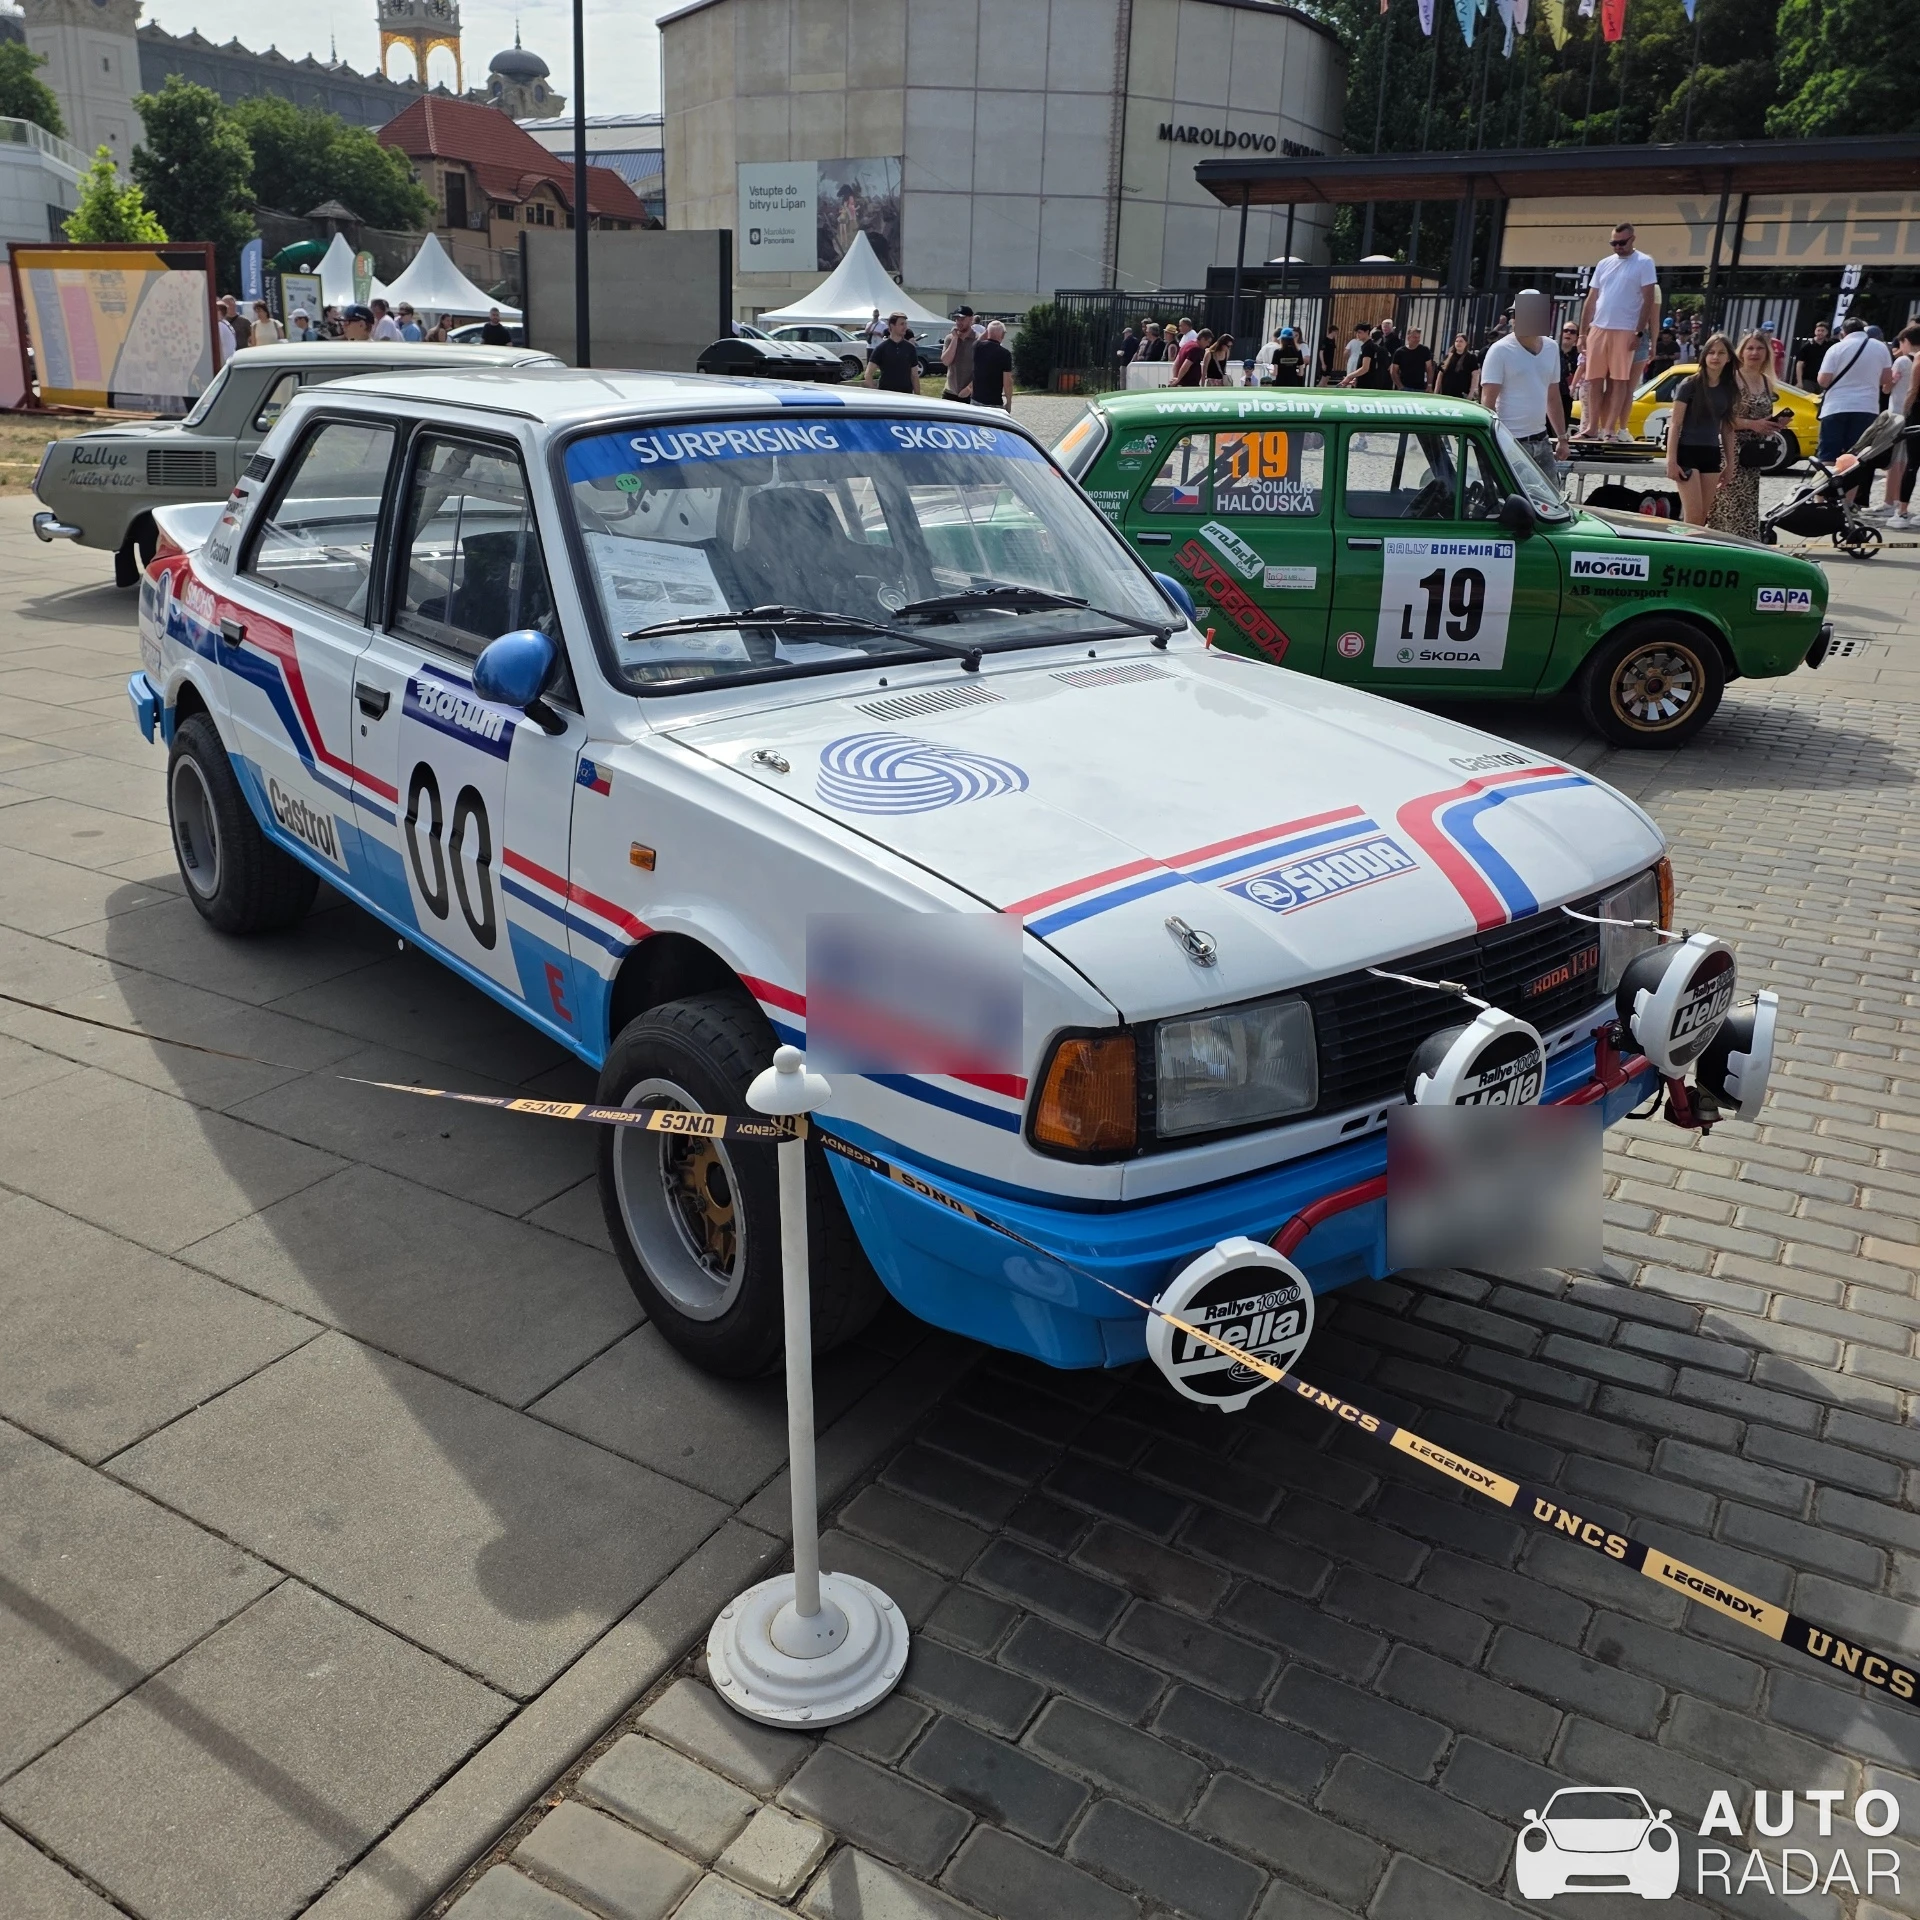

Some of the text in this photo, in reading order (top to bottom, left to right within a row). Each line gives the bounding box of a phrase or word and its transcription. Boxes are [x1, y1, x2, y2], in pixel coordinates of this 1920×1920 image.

[1159, 123, 1277, 152] MAROLDOVO
[749, 185, 798, 200] Vstupte do
[749, 200, 771, 211] bitvy
[780, 199, 806, 211] Lipan
[763, 228, 796, 236] Maroldovo
[1155, 401, 1230, 413] www.
[1238, 399, 1322, 418] plosiny
[1345, 401, 1463, 417] bahnik.cz
[71, 446, 129, 470] Rallye
[630, 425, 839, 463] SURPRISING
[618, 477, 638, 487] 118
[1251, 478, 1314, 497] Soukup
[1216, 495, 1315, 512] HALOUSKA
[209, 538, 232, 566] Castrol
[1386, 542, 1429, 555] RALLY
[1430, 543, 1493, 557] BOHEMIA
[1573, 560, 1646, 578] MOGUL
[1660, 564, 1740, 590] ŠKODA
[186, 582, 216, 619] SACHS
[1174, 539, 1291, 664] SVOBODA
[1419, 567, 1486, 642] 19
[1569, 585, 1669, 599] AB motorsport
[1419, 649, 1481, 662] ŠKODA
[417, 680, 506, 742] Barum
[1448, 752, 1530, 772] Castrol
[269, 778, 339, 861] Castrol
[404, 761, 496, 950] 00
[1281, 842, 1414, 899] ŠKODA
[1572, 946, 1598, 976] 130
[1674, 987, 1731, 1037] Hella
[1479, 1048, 1540, 1088] Rallye 1000
[517, 1101, 573, 1116] UNCS
[587, 1109, 642, 1123] LEGENDY
[660, 1113, 715, 1135] UNCS
[736, 1123, 784, 1137] EGENDY
[820, 1134, 878, 1168] LEGENDY
[901, 1172, 965, 1214] UNCS
[1204, 1285, 1301, 1321] Rallye 1000
[1181, 1309, 1300, 1360] Hella
[1296, 1381, 1381, 1433] UNCS
[1409, 1439, 1496, 1490] LEGENDY
[1533, 1497, 1628, 1560] UNCS
[1661, 1563, 1764, 1623] LEGENDY
[1806, 1626, 1917, 1698] UNCS
